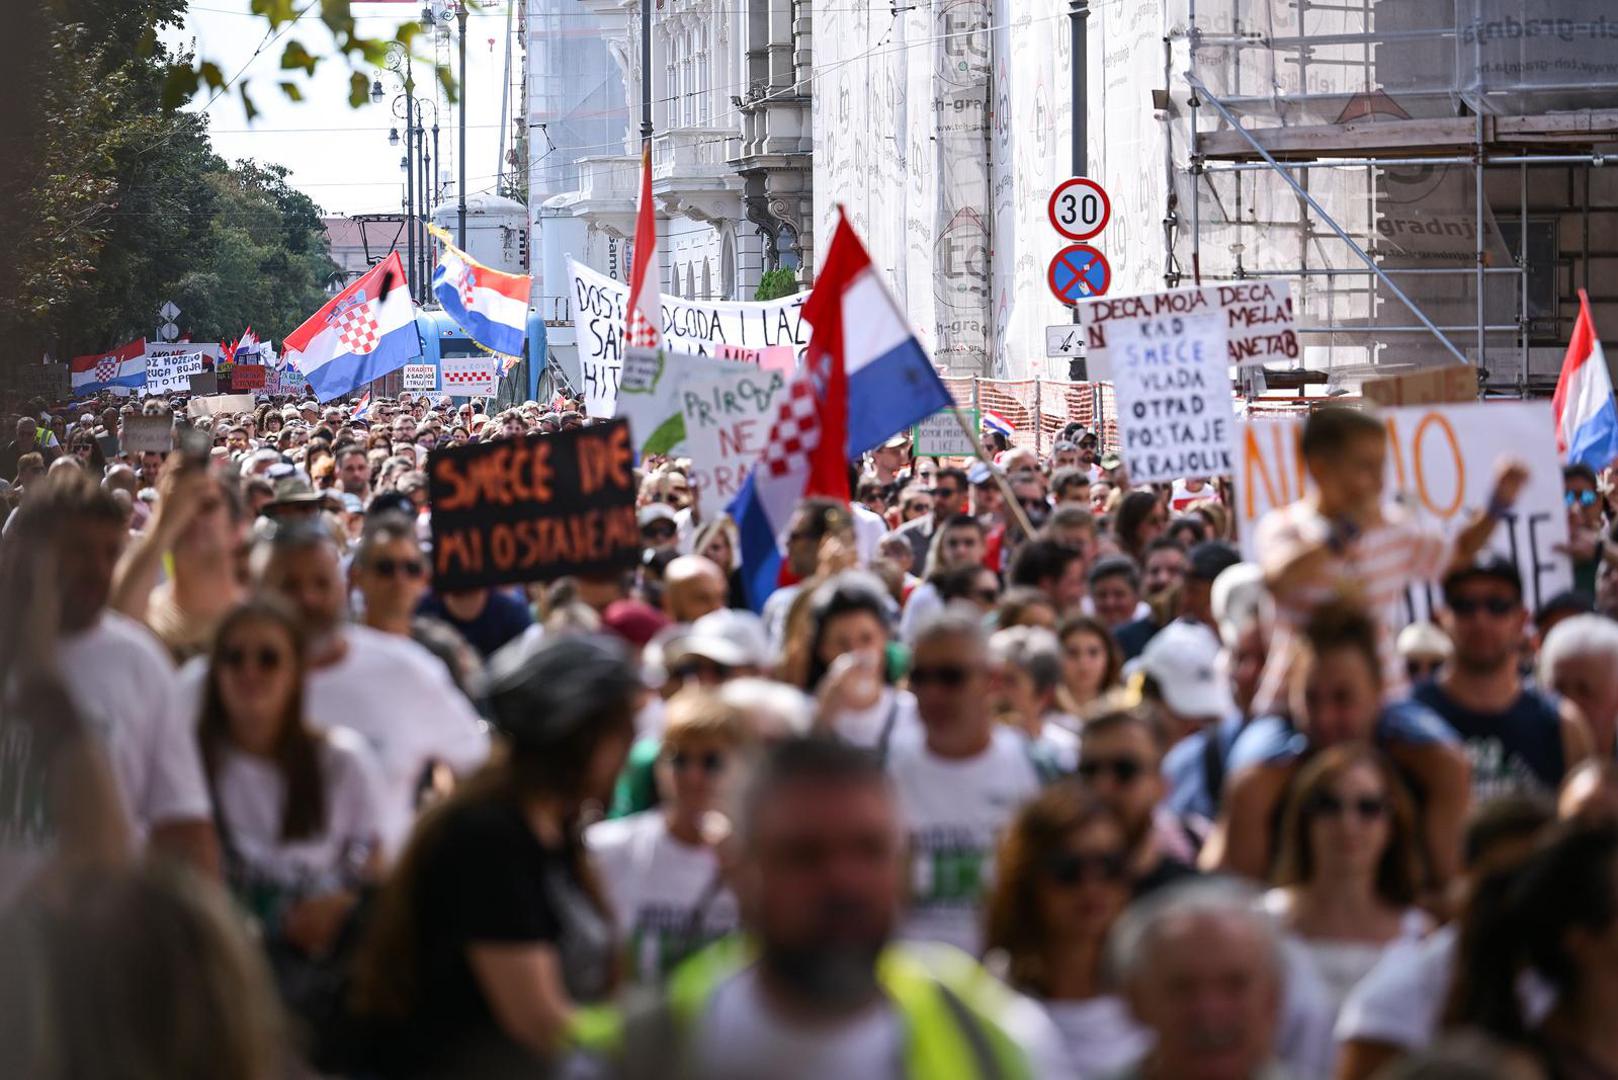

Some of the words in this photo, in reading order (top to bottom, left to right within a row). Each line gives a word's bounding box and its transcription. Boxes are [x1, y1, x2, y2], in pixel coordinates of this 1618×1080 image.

[1061, 194, 1097, 224] 30
[575, 277, 624, 320] DOST
[740, 310, 746, 346] I
[762, 297, 807, 347] LAŽ
[1155, 289, 1207, 315] MOJA
[1217, 284, 1276, 307] DECA
[1141, 369, 1205, 391] VLADA
[684, 373, 784, 426] PRIRODA
[1132, 394, 1204, 419] OTPAD
[1127, 418, 1225, 448] POSTAJE
